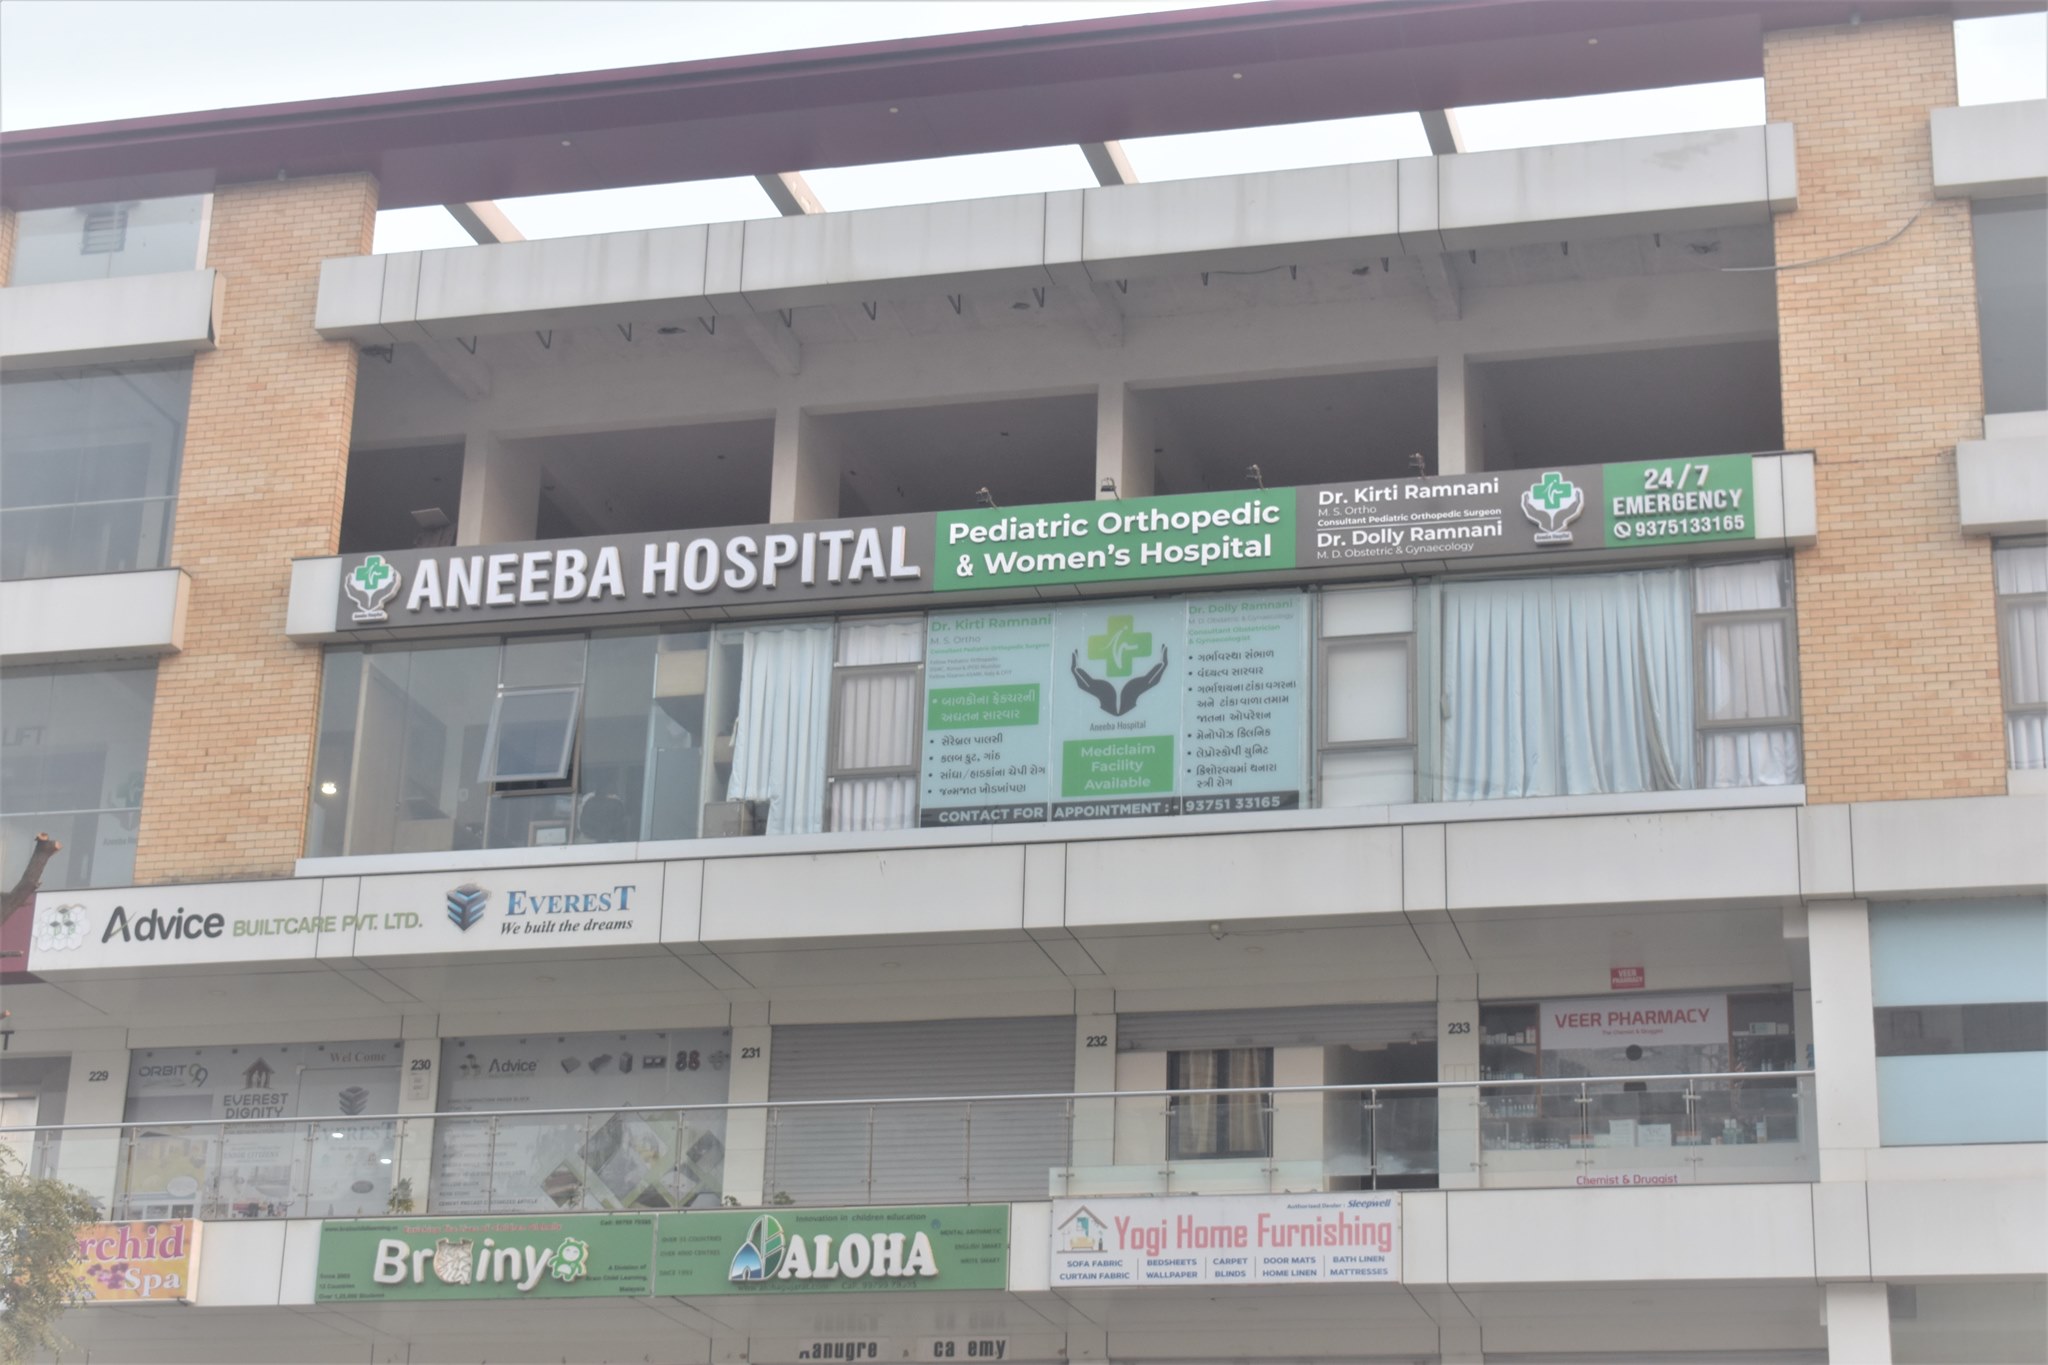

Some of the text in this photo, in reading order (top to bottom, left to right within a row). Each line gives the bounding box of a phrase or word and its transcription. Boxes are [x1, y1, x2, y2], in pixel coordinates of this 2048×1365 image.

[1644, 463, 1710, 490] 24/7
[1318, 477, 1499, 506] Dr. Kirti Ramnani
[1613, 489, 1743, 517] EMERGENCY
[1317, 505, 1377, 517] M. S. Ortho
[1318, 508, 1501, 527] Consultant Pediatric Orthopedic Surgeon
[950, 499, 1280, 545] Pediatric Orthopedic
[1635, 515, 1745, 538] 9375133165
[1317, 521, 1503, 548] Dr. Dolly Ramnani
[956, 554, 974, 577] &
[1141, 533, 1271, 566] Hospital
[1317, 543, 1474, 560] M. D. Obstetric & Gynaecology
[407, 526, 921, 611] ANEEBA HOSPITAL
[1189, 599, 1293, 615] Dr. Dolly Ramnani
[931, 614, 1052, 632] Dr. Kirti Ramnani
[1189, 628, 1230, 636] Consultant
[953, 634, 981, 644] Ortho
[1232, 667, 1264, 677] સારવાર
[1266, 680, 1296, 690] વગરના
[1197, 697, 1214, 708] અને
[1264, 695, 1289, 703] તમામ
[983, 709, 1020, 721] સારવાર
[1230, 709, 1271, 721] ઓપરેશન
[1090, 720, 1146, 732] Aneeba Hospital
[975, 732, 1003, 744] પાલસી
[1081, 744, 1156, 757] Mediclaim
[1030, 764, 1046, 775] રોગ
[1092, 759, 1143, 773] Facility
[1085, 776, 1150, 790] Available
[1217, 776, 1233, 787] રોગ
[939, 796, 1281, 823] CONTACT FOR APPOINTMENT 93751 33165
[101, 906, 424, 944] Advice BUILTCARE PVT. LTD.
[501, 912, 634, 935] We built the dreams
[1555, 1008, 1710, 1029] VEER PHARMACY
[1448, 1022, 1470, 1035] 233
[1087, 1035, 1107, 1048] 232
[741, 1047, 761, 1059] 231
[139, 1064, 187, 1078] ORBIT
[411, 1059, 431, 1071] 230
[489, 1059, 537, 1073] Advice
[88, 1070, 109, 1087] 229
[223, 1093, 290, 1107] EVEREST
[225, 1106, 284, 1120] DIGNITY
[1576, 1174, 1619, 1185] Chemist
[1622, 1174, 1630, 1184] &
[1347, 1198, 1391, 1209] Sleepwell
[796, 1212, 926, 1223] Innovation in children education
[1114, 1211, 1392, 1257] Yogi Home Furnishing
[79, 1223, 184, 1262] rchid
[778, 1231, 940, 1279] ALOHA
[1213, 1256, 1248, 1265] CARPET
[1263, 1255, 1317, 1265] DOOR MATS
[1333, 1254, 1385, 1264] BATH LINEN
[1067, 1258, 1124, 1268] SOFA FABRIC
[1147, 1257, 1197, 1267] BEDSHEETS
[1060, 1270, 1131, 1281] CURTAIN FABRIC
[1147, 1270, 1198, 1280] WALLPAPER
[1215, 1269, 1247, 1278] BLINDS
[1262, 1267, 1318, 1277] HOME LINEN
[1330, 1266, 1389, 1276] MATTRESSES
[125, 1266, 181, 1298] Spa
